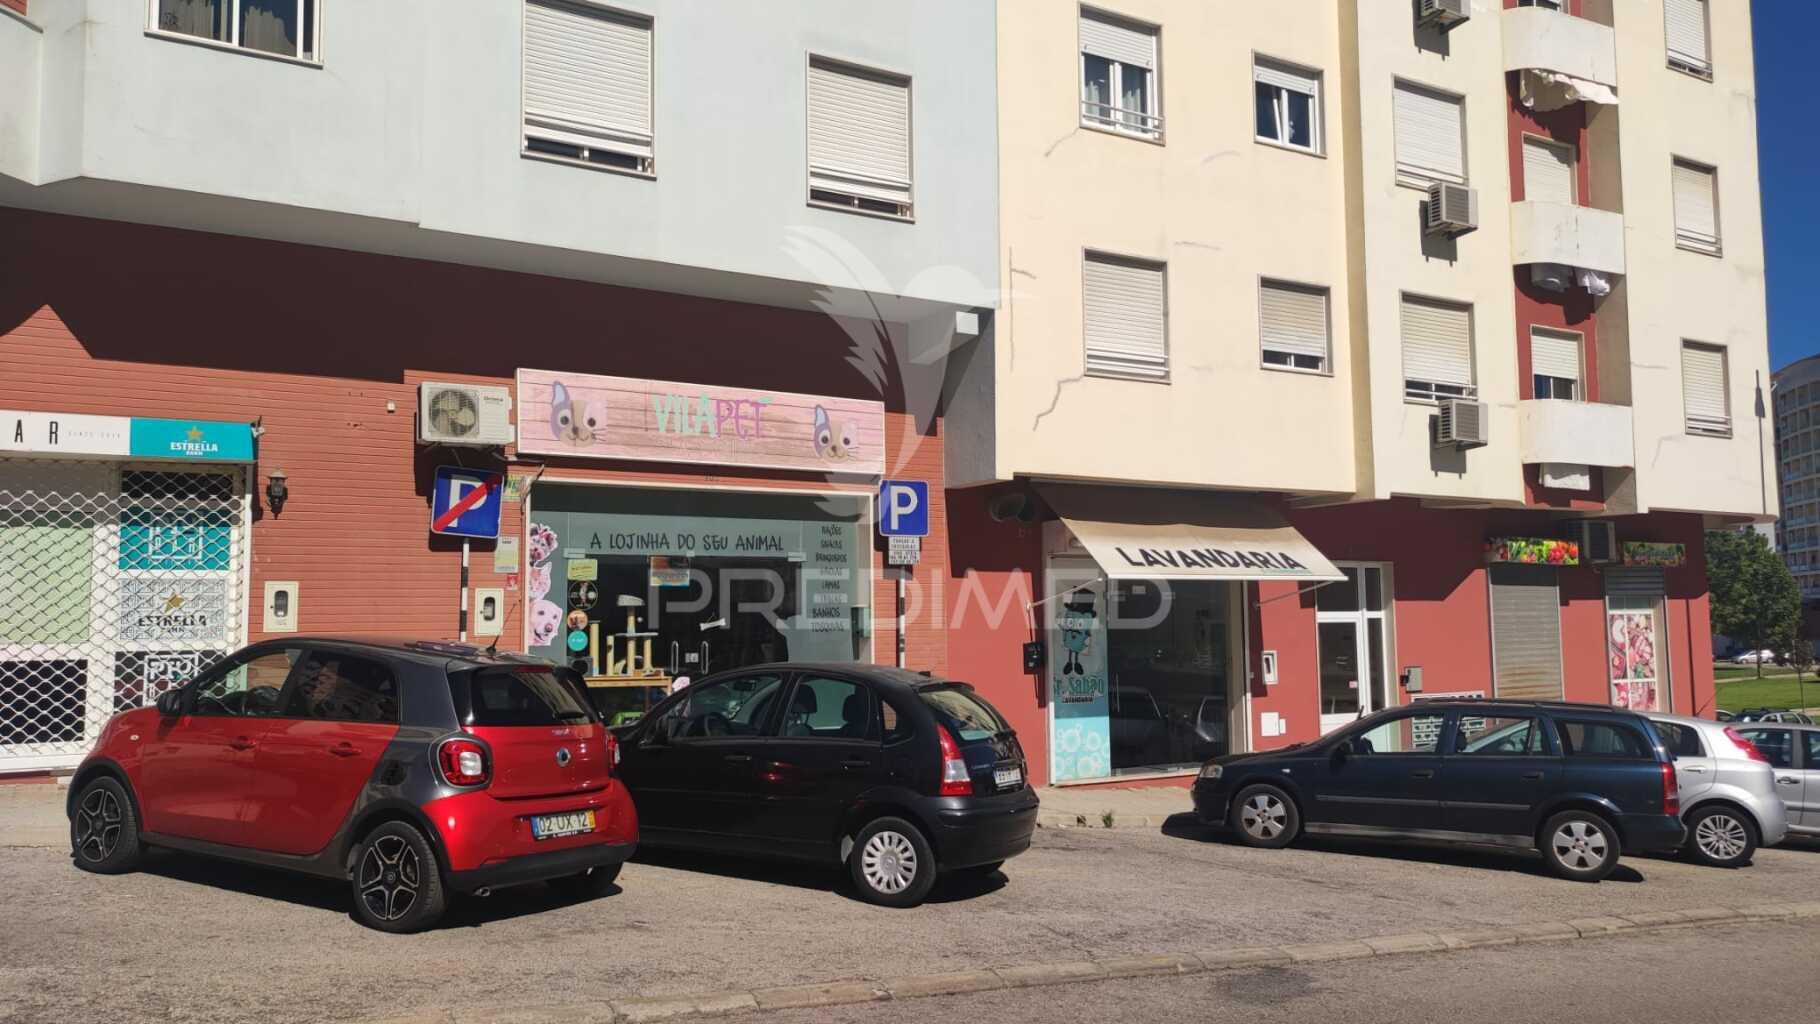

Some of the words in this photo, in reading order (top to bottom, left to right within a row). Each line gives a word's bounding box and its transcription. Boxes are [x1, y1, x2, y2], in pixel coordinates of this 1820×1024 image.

[170, 441, 218, 452] ESTRELLA
[890, 485, 918, 530] P
[590, 532, 602, 549] A
[610, 532, 670, 550] LOJINHA
[677, 534, 696, 550] DO
[703, 534, 728, 551] SEU
[736, 535, 785, 551] ANIMAL
[1115, 546, 1308, 570] LAVANDARIA
[812, 607, 841, 619] BANHOS
[539, 816, 553, 833] 02
[557, 815, 572, 830] UX
[577, 813, 588, 828] 12
